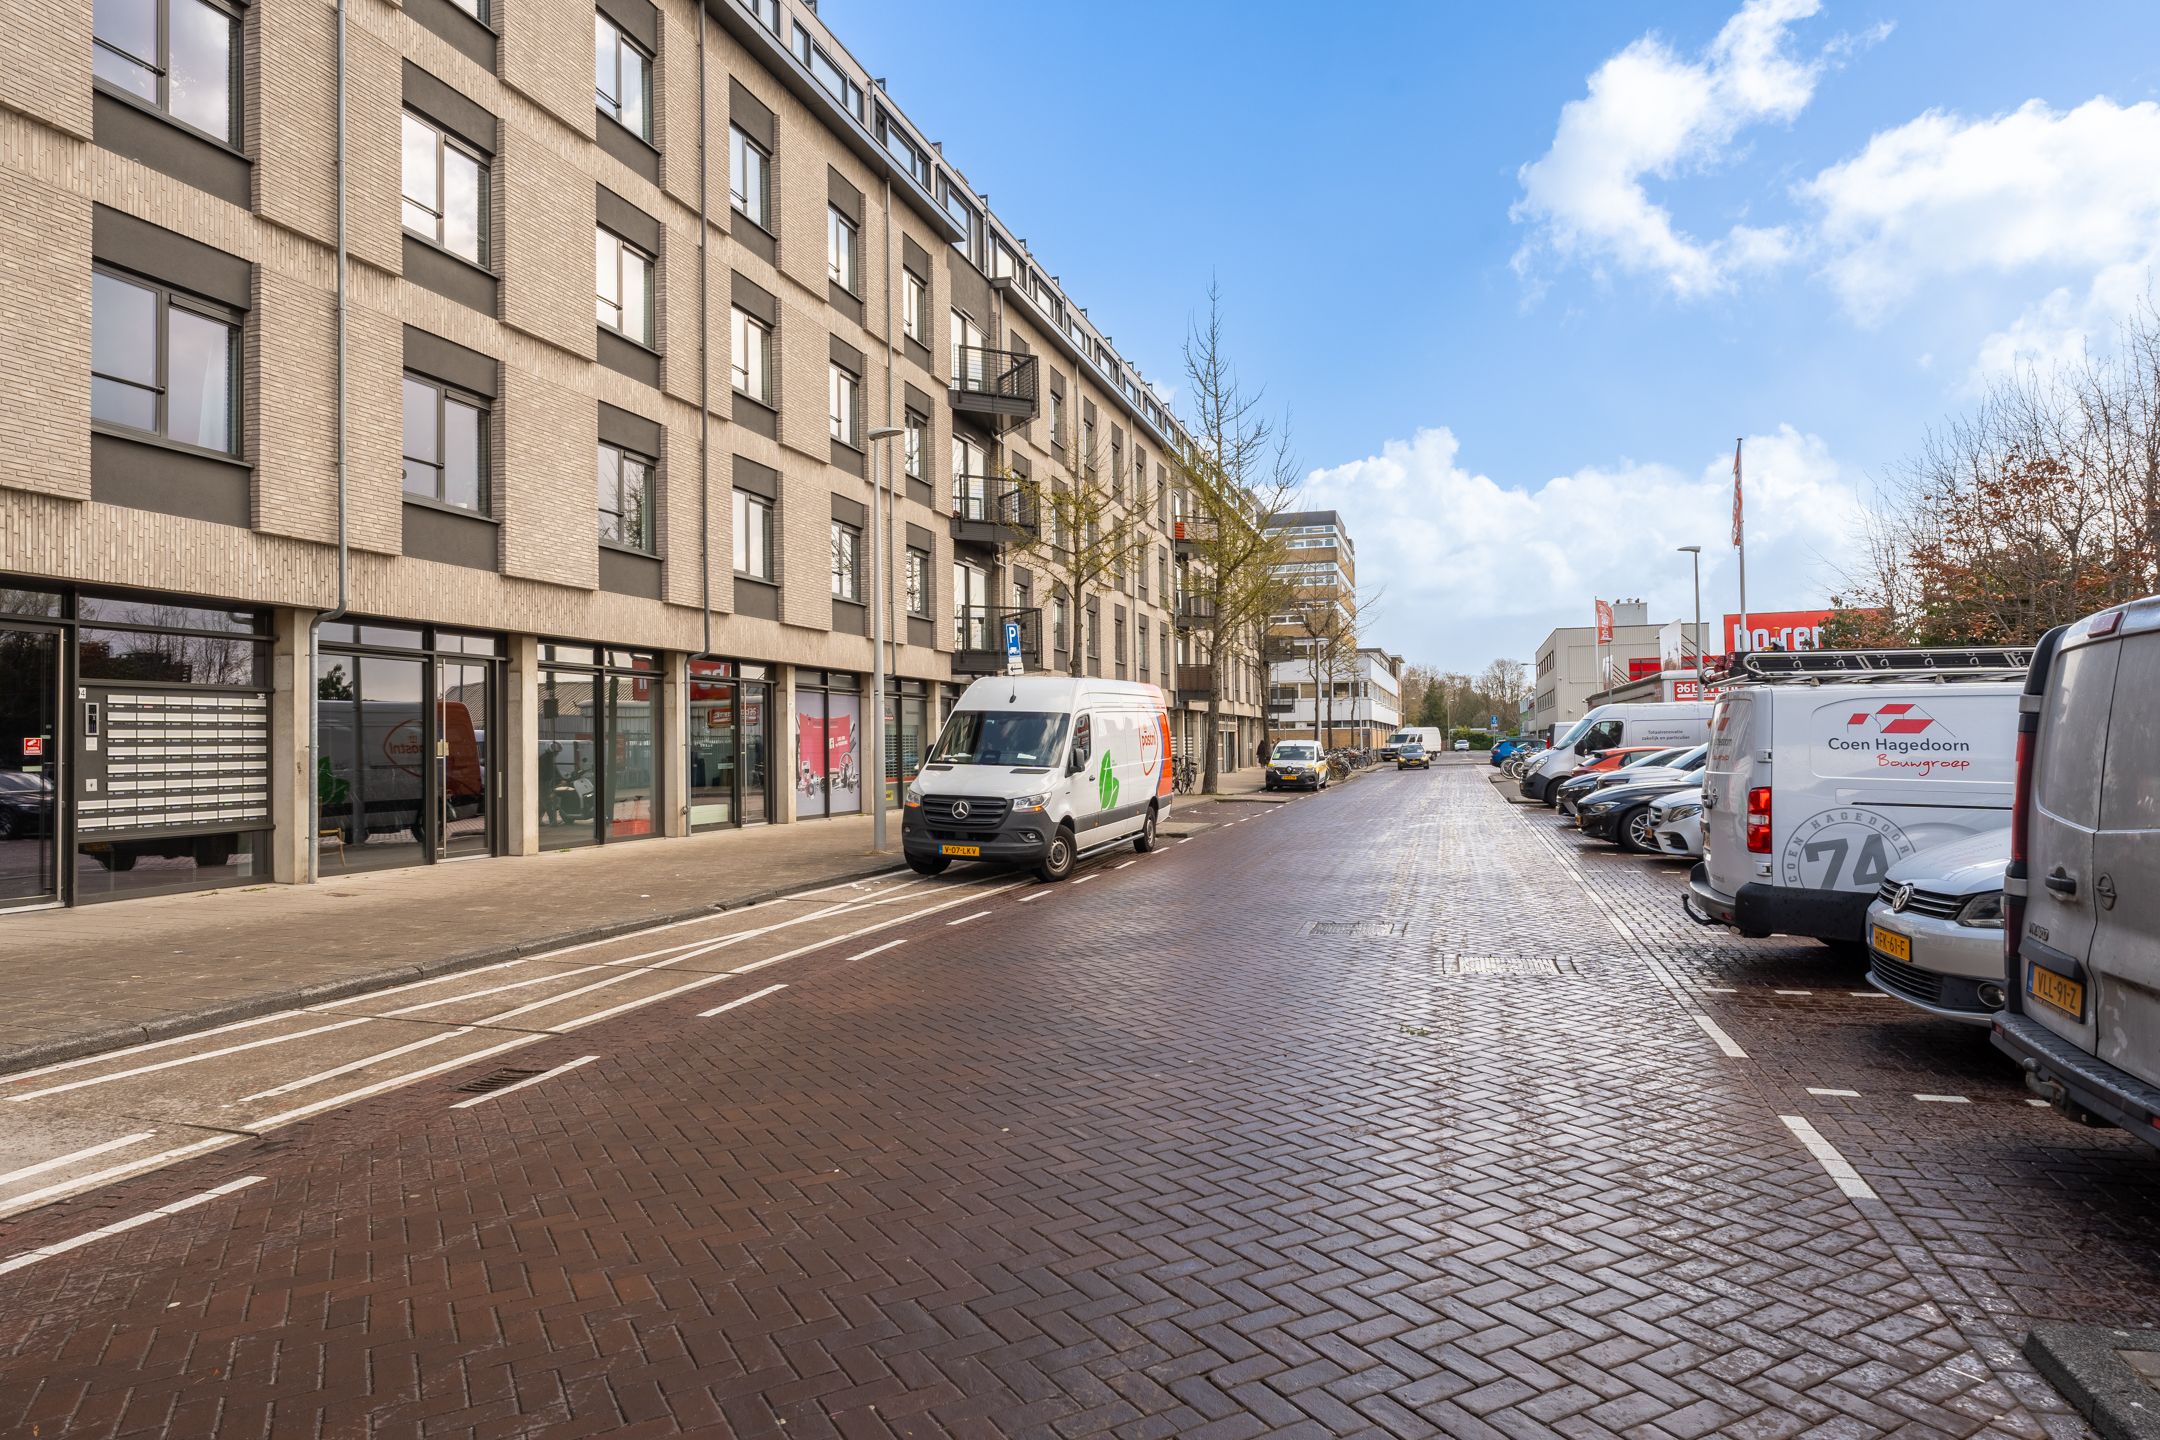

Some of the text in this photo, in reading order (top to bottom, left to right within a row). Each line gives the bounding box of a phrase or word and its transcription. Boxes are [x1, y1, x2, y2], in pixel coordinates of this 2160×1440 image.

[1009, 626, 1017, 643] P
[1734, 624, 1826, 651] bo-ren
[1828, 738, 1970, 754] Coen Hagedoorn
[1877, 754, 1970, 777] Bouwgroep
[1786, 812, 1911, 883] COEN HAGEDOOR
[1804, 833, 1889, 890] 74
[2037, 971, 2078, 1010] VLL-91-Z
